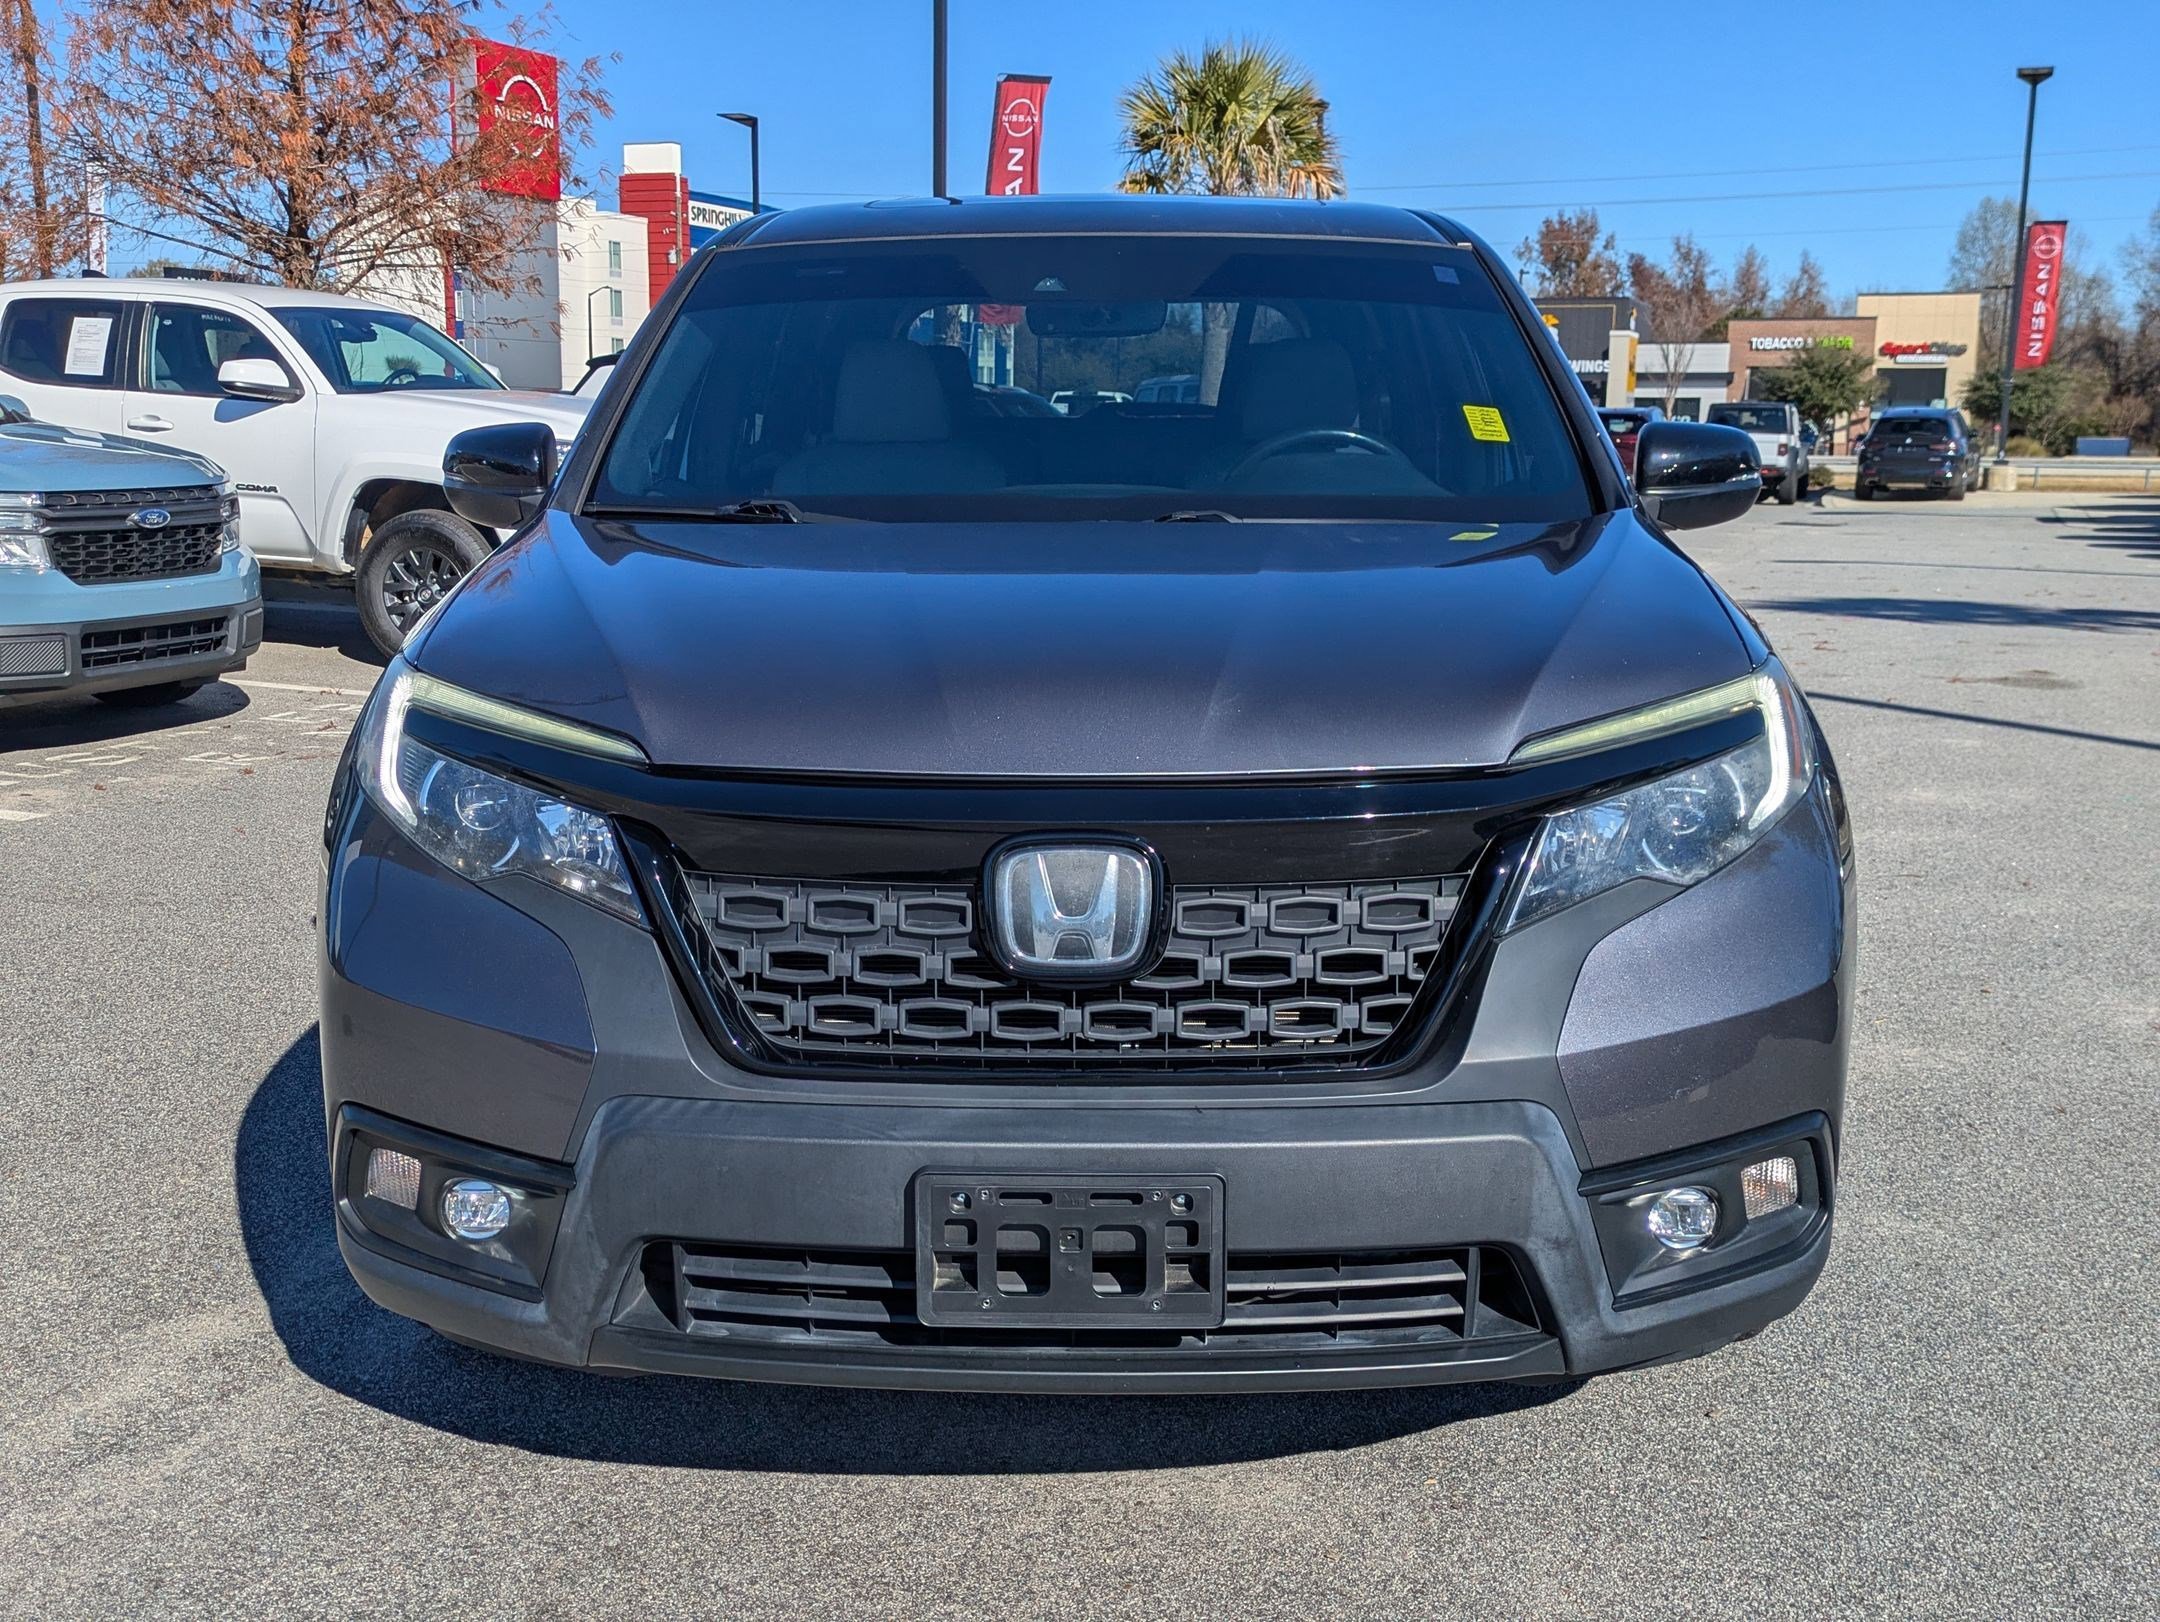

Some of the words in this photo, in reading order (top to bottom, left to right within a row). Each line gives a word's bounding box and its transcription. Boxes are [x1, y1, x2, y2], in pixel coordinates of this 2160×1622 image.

[1002, 115, 1039, 123] NISSAN
[2027, 263, 2051, 357] NISSAN
[1751, 336, 1804, 350] TOBACCO
[1568, 359, 1611, 373] WINGS
